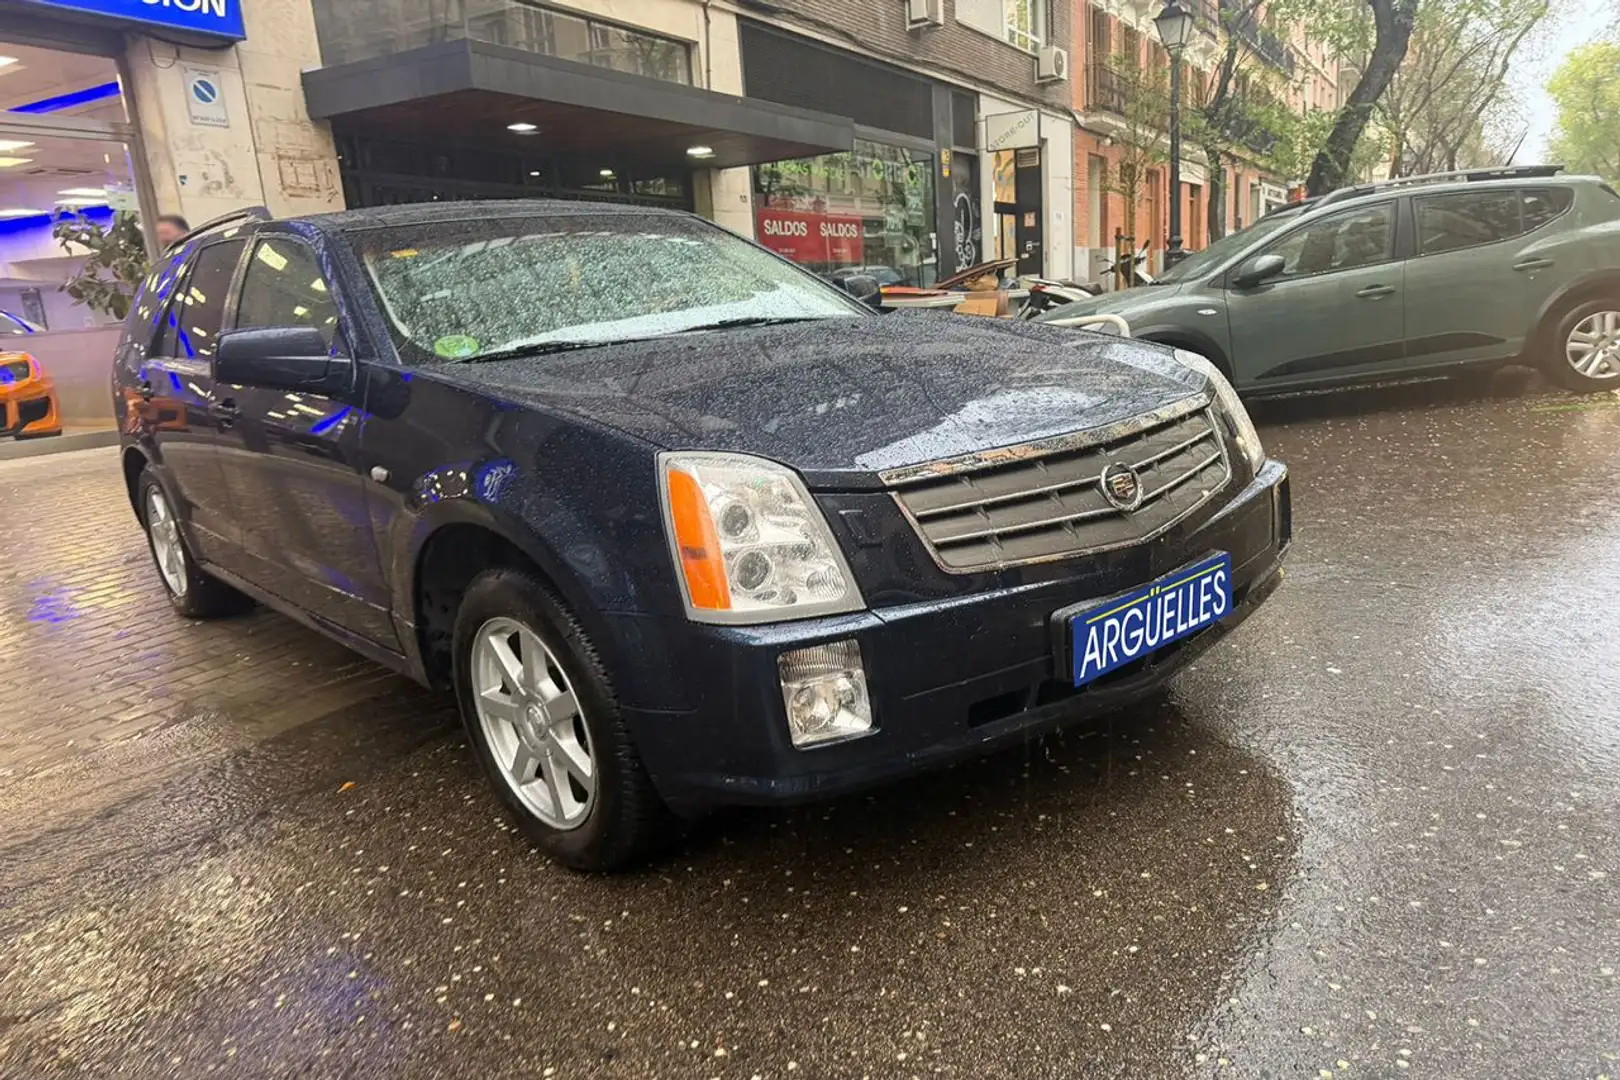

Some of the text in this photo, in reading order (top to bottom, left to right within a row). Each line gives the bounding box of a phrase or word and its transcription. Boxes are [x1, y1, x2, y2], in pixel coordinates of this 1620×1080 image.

[763, 219, 858, 237] SALDOS SALDOS
[1079, 569, 1226, 679] ARGÜELLES
